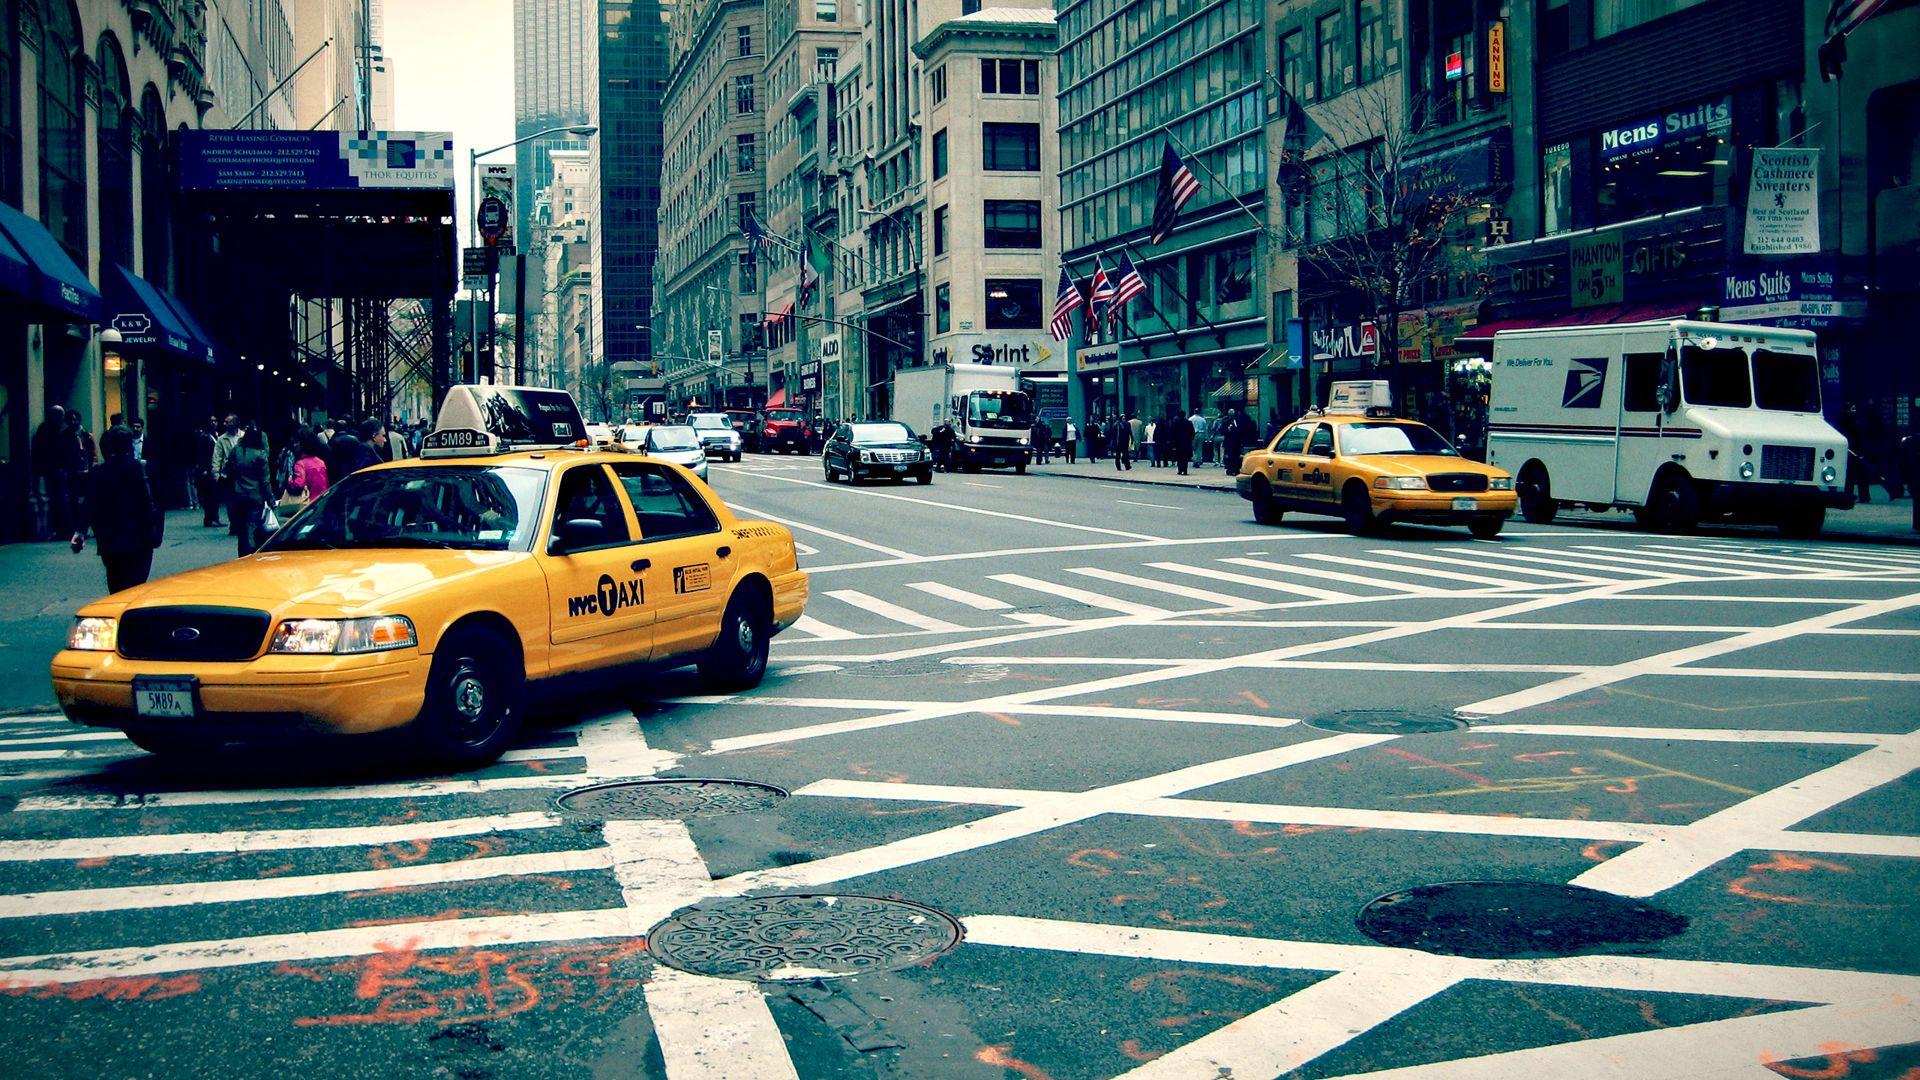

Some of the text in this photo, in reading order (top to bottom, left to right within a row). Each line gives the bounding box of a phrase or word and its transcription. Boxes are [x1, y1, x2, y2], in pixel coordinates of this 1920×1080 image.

[1491, 28, 1502, 88] TANNING
[1602, 123, 1659, 151] Mens
[1665, 103, 1728, 134] Suits
[1544, 141, 1570, 155] TUXEDO
[1761, 154, 1810, 167] Scottish
[364, 170, 438, 180] THOR EQUITIES
[1753, 167, 1815, 180] Cashmere
[1754, 180, 1811, 192] Sweaters
[1778, 208, 1810, 216] Scotland
[1750, 243, 1792, 252] Established
[1572, 241, 1622, 268] PHANTOM
[1630, 240, 1687, 275] GIFTS
[1511, 263, 1556, 294] GIFTS
[1800, 271, 1833, 284] Mens Suits
[1725, 270, 1791, 300] Mens Suits
[1820, 303, 1833, 315] OFF
[121, 320, 127, 328] K
[136, 320, 144, 328] W
[124, 336, 157, 344] JEWELRY
[822, 339, 839, 357] ALDO
[1506, 358, 1515, 367] We
[1515, 357, 1534, 367] Deliver
[1533, 357, 1541, 367] For
[441, 432, 473, 446] 5M89
[568, 574, 645, 617] NYC TAXI
